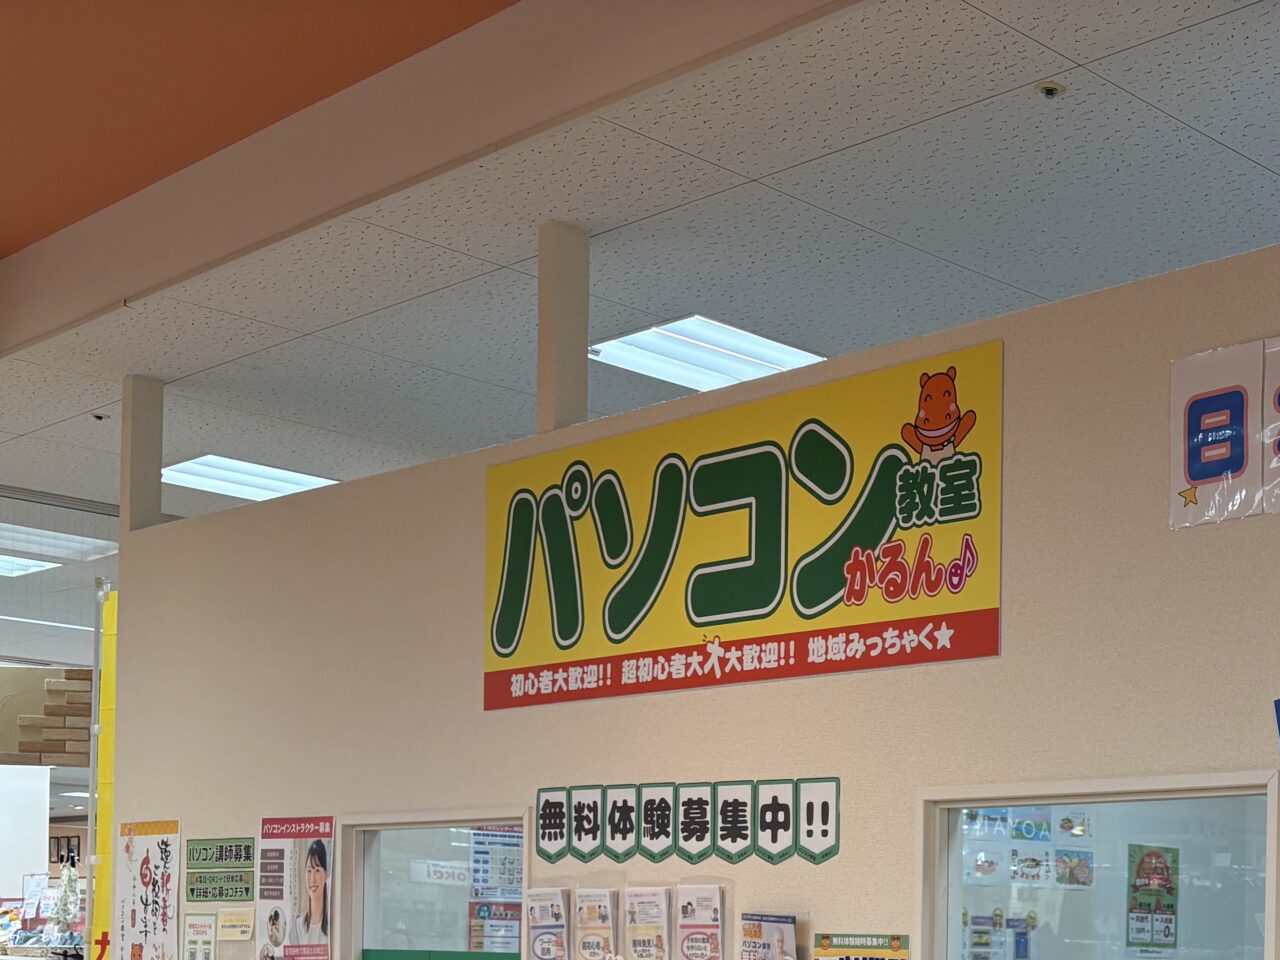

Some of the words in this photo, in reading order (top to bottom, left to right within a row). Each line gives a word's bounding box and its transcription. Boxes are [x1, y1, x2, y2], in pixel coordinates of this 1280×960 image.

[510, 662, 612, 698] 初心者大歓迎!!
[539, 795, 830, 844] 無料体験募集中!!
[188, 845, 253, 863] パソコン講師募集
